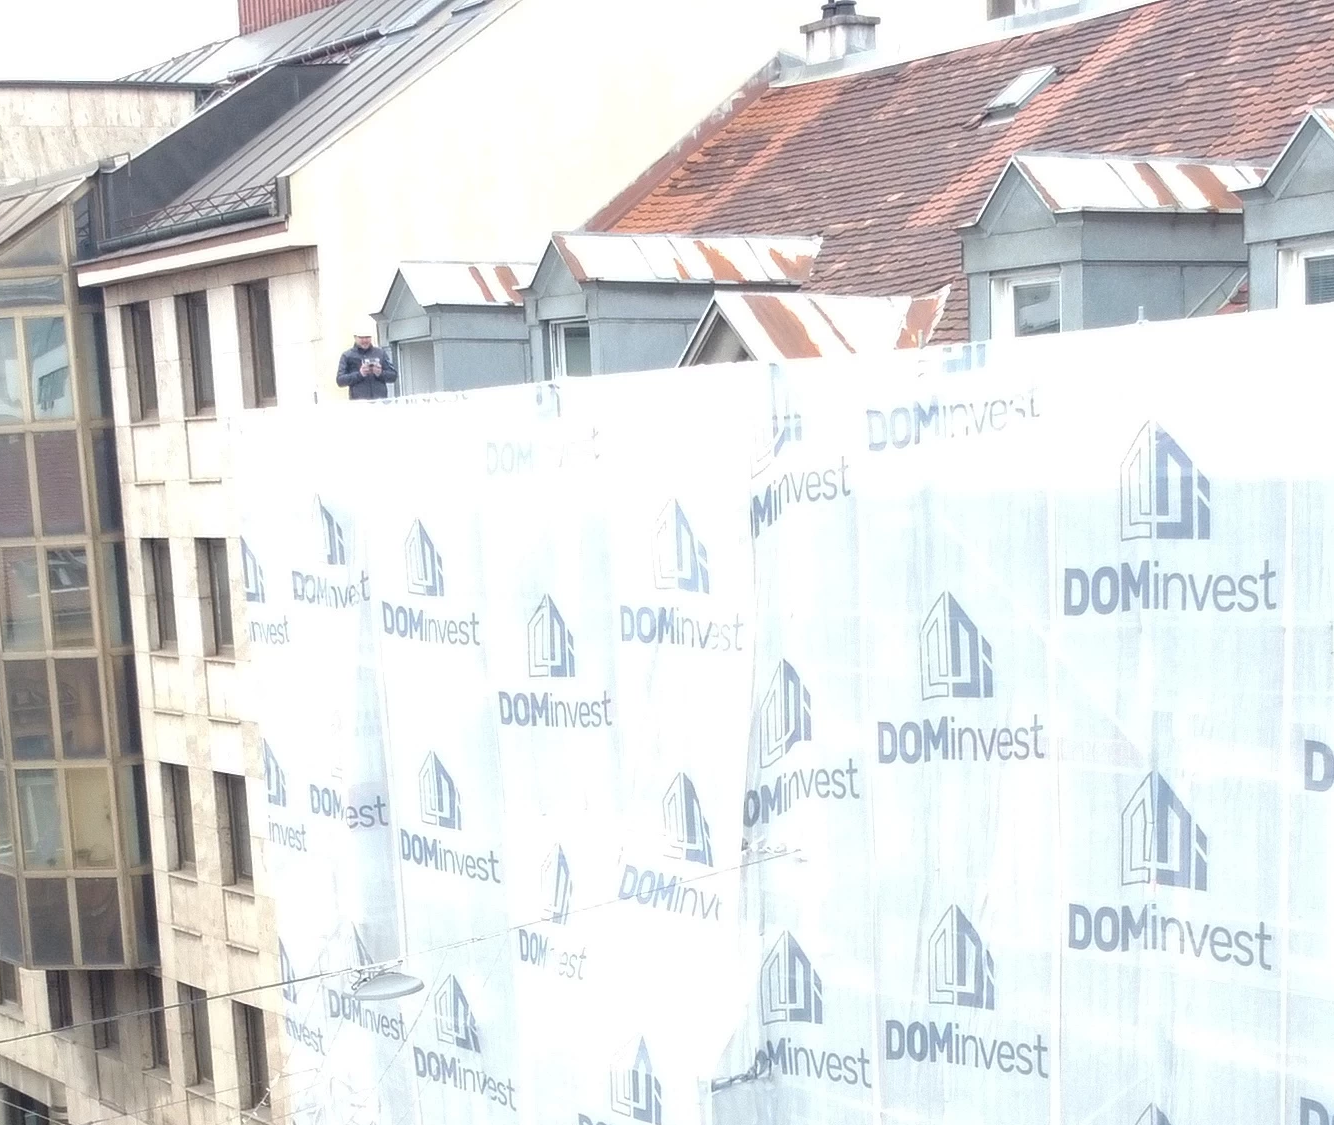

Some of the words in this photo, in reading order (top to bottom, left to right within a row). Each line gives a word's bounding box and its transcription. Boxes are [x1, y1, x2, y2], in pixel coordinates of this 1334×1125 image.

[1064, 559, 1277, 616] DOMinvest
[382, 600, 481, 646] DOMinvest
[620, 604, 744, 652] DOMinvest
[498, 690, 613, 728] DOMinvest
[878, 714, 1045, 765] DOMinvest
[400, 828, 502, 884] DOMinvest
[1069, 903, 1272, 971] DOMinvest
[885, 1019, 1049, 1080] DOMinvest
[413, 1045, 517, 1112] DOMinvest
